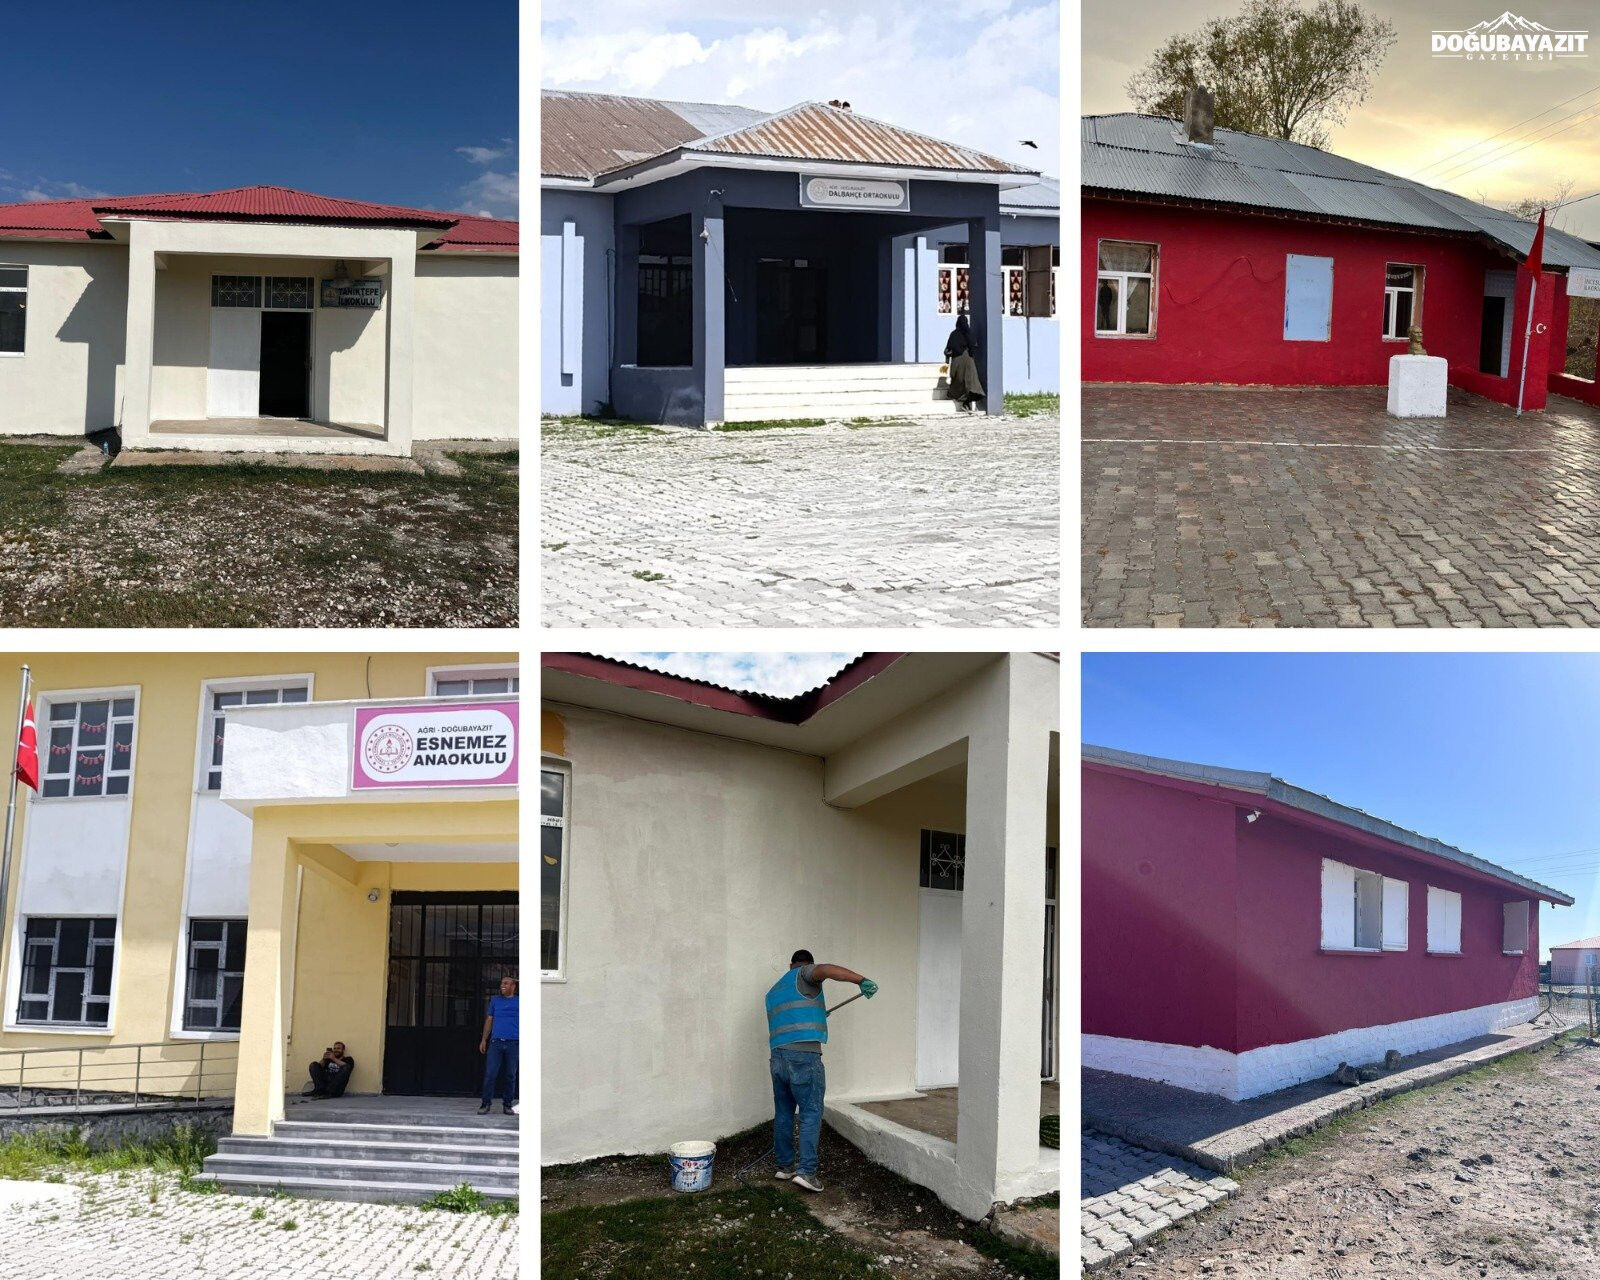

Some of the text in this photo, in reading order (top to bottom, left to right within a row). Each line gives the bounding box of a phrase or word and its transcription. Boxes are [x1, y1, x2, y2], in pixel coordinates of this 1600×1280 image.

[828, 190, 900, 200] DALBAHÇE ORTAOKULU
[338, 296, 376, 306] İLKOKULU
[416, 735, 507, 751] ESNEMEZ
[413, 752, 507, 766] ANAOKULU
